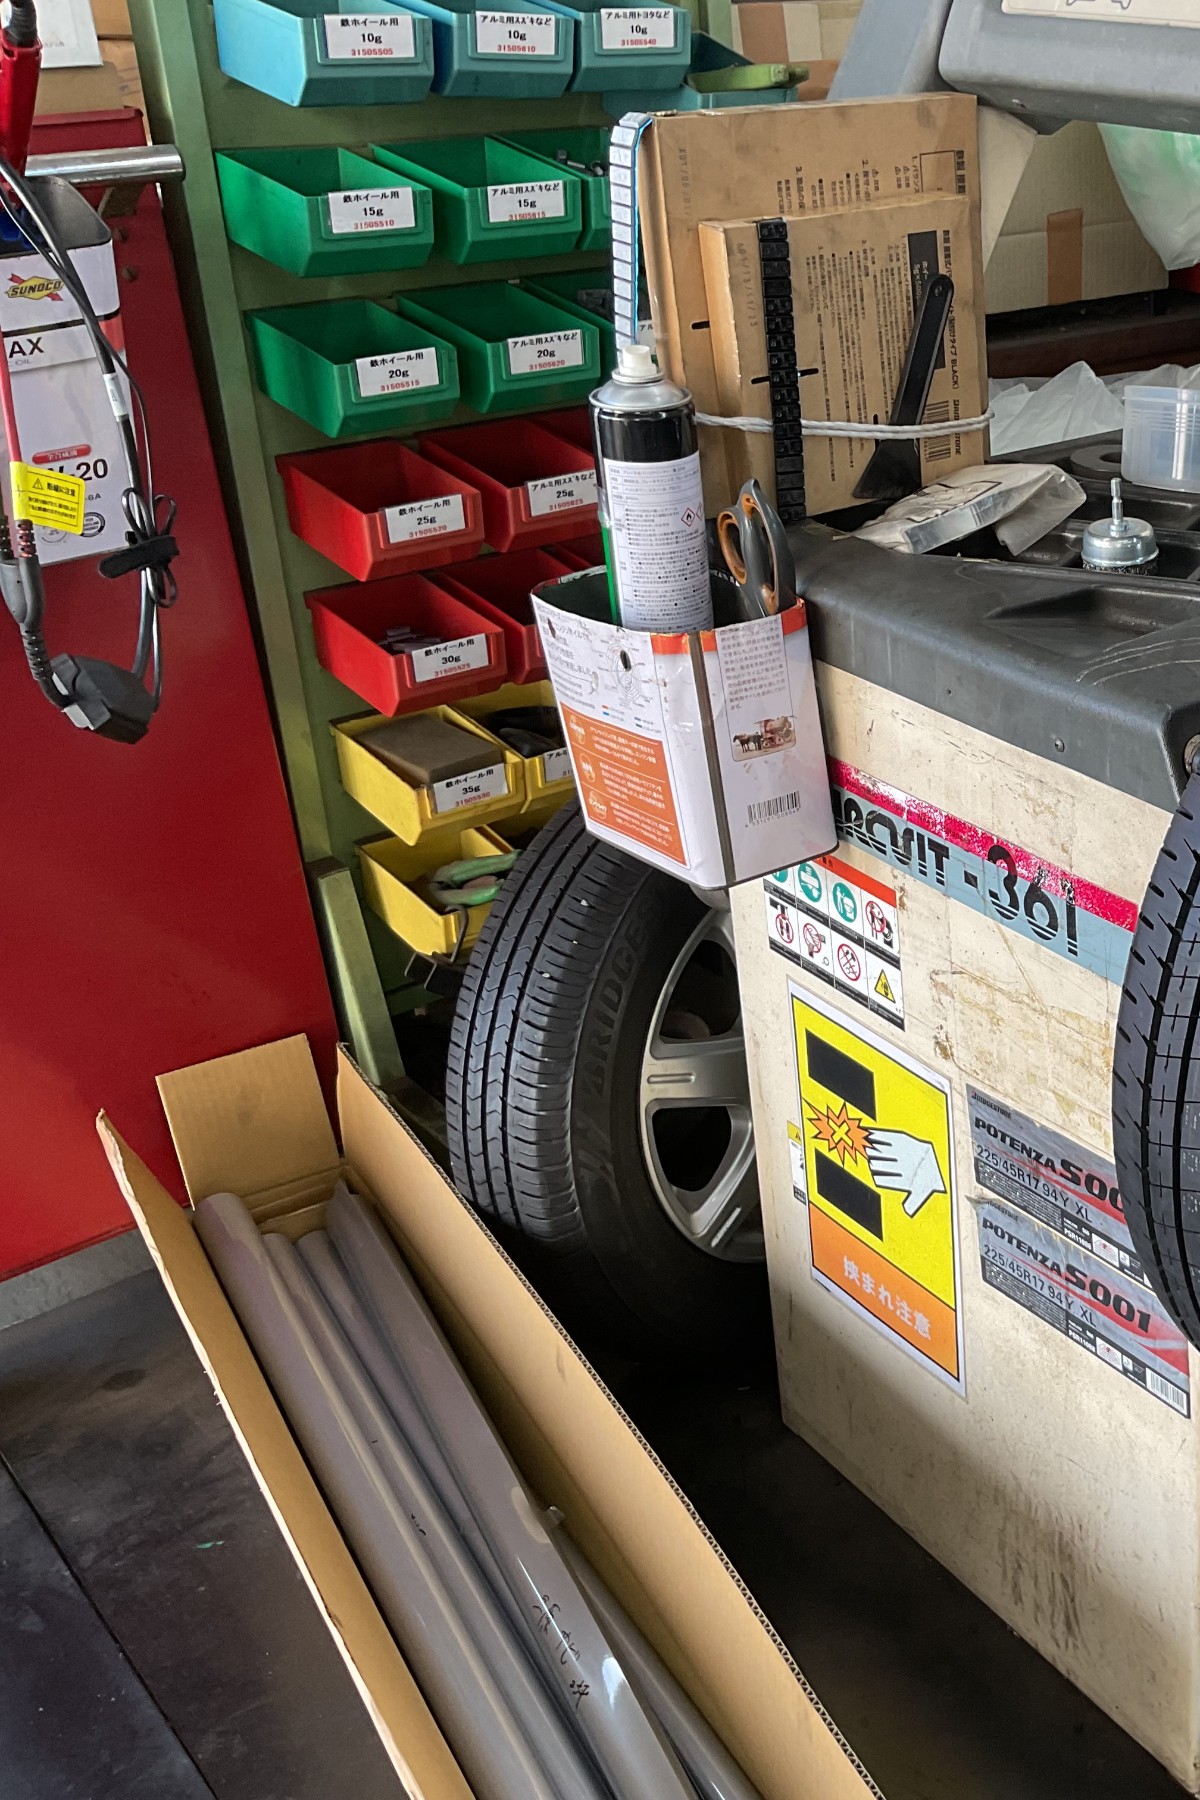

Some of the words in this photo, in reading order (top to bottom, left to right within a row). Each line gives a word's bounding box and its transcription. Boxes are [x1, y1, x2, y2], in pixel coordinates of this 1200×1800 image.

[340, 17, 399, 27] 鉄ホイール用
[508, 30, 527, 41] 10g
[630, 25, 647, 35] 10g
[361, 33, 382, 44] 10g
[343, 191, 400, 203] 鉄ホイール用
[517, 198, 536, 209] 15g
[363, 206, 384, 217] 15g
[11, 280, 62, 296] SUNOCO
[9, 337, 44, 358] AX
[370, 352, 424, 367] 鉄ホイール用
[537, 349, 556, 359] 20g
[388, 369, 409, 379] 20g
[556, 489, 574, 499] 25g
[399, 498, 451, 516] 鉄ホイール用
[417, 516, 436, 526] 25g
[441, 655, 461, 665] 30g
[462, 785, 481, 795] 35g
[974, 1117, 1057, 1173] POTENZA
[977, 1144, 1040, 1190] 225/45R17
[1075, 1201, 1093, 1223] XL
[982, 1217, 1062, 1277] POTENZA
[1065, 1263, 1151, 1334] S001
[984, 1244, 1045, 1292] 225/45R17
[1080, 1306, 1097, 1328] XL
[842, 1255, 932, 1341] 挟まれ注意
